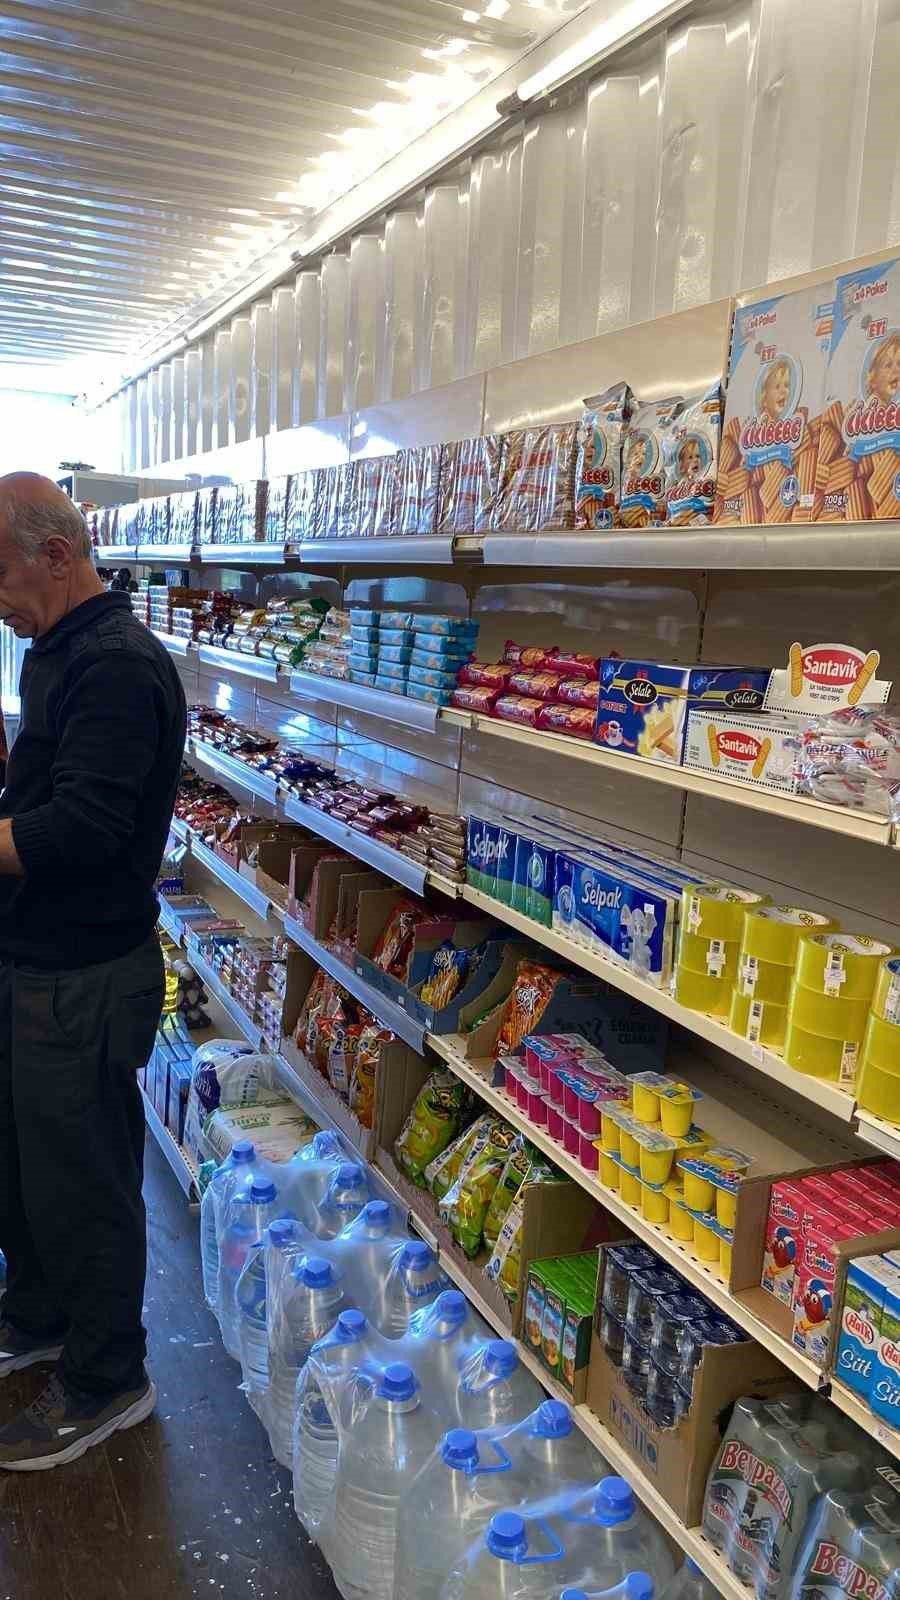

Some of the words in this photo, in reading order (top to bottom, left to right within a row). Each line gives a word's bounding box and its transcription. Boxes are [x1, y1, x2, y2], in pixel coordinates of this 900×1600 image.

[803, 655, 858, 679] Santavik
[719, 735, 758, 757] Santavik
[470, 833, 510, 865] Selpak
[581, 881, 622, 912] Selpak
[848, 1313, 872, 1341] Halk
[840, 1349, 873, 1378] Süt
